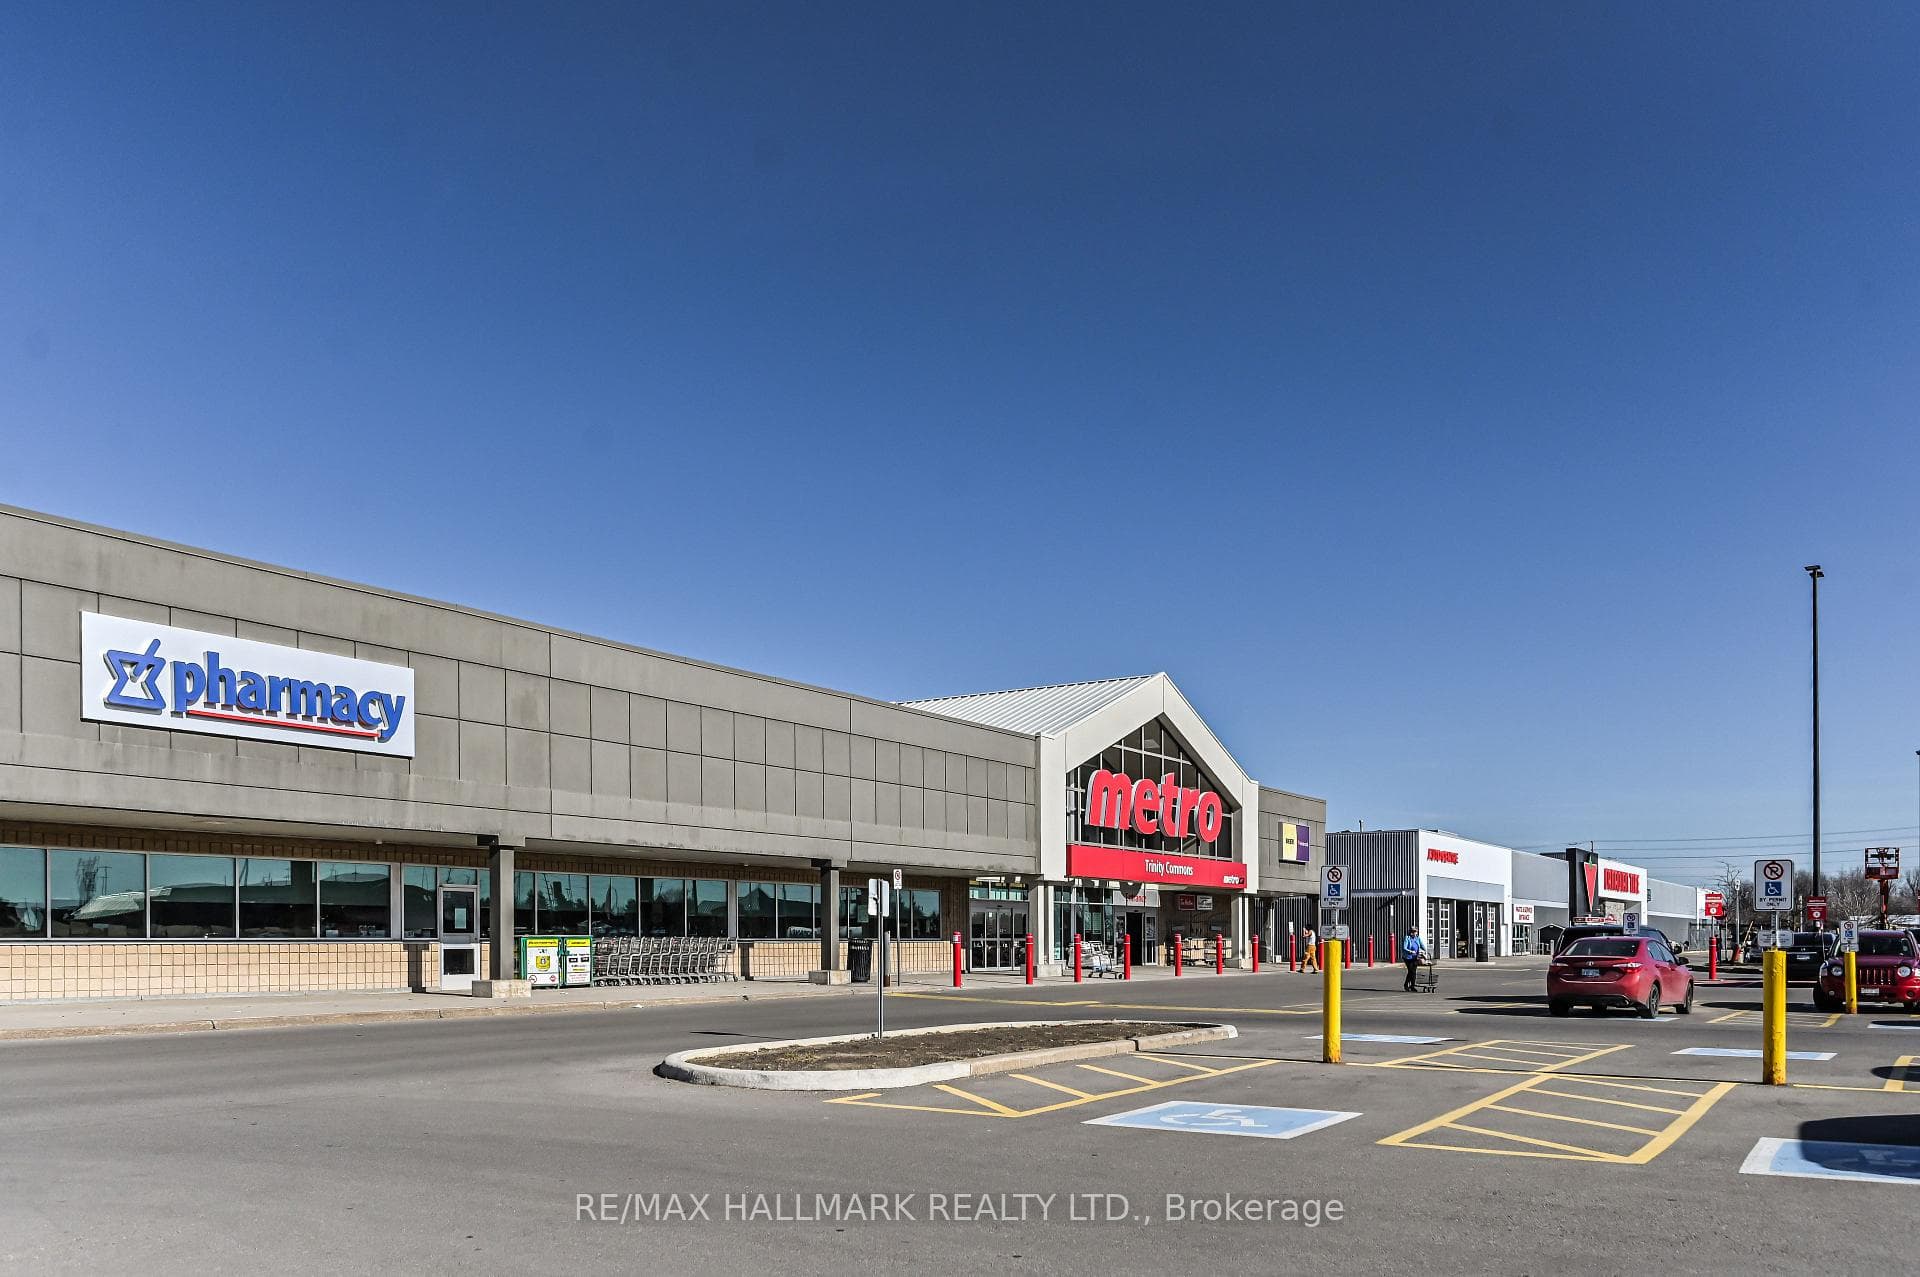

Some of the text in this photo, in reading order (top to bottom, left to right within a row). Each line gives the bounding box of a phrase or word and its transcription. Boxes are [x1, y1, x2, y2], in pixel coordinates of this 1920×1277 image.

[170, 651, 405, 743] pharmacy
[1085, 769, 1222, 843] metro
[1145, 859, 1193, 876] Trinity Commons
